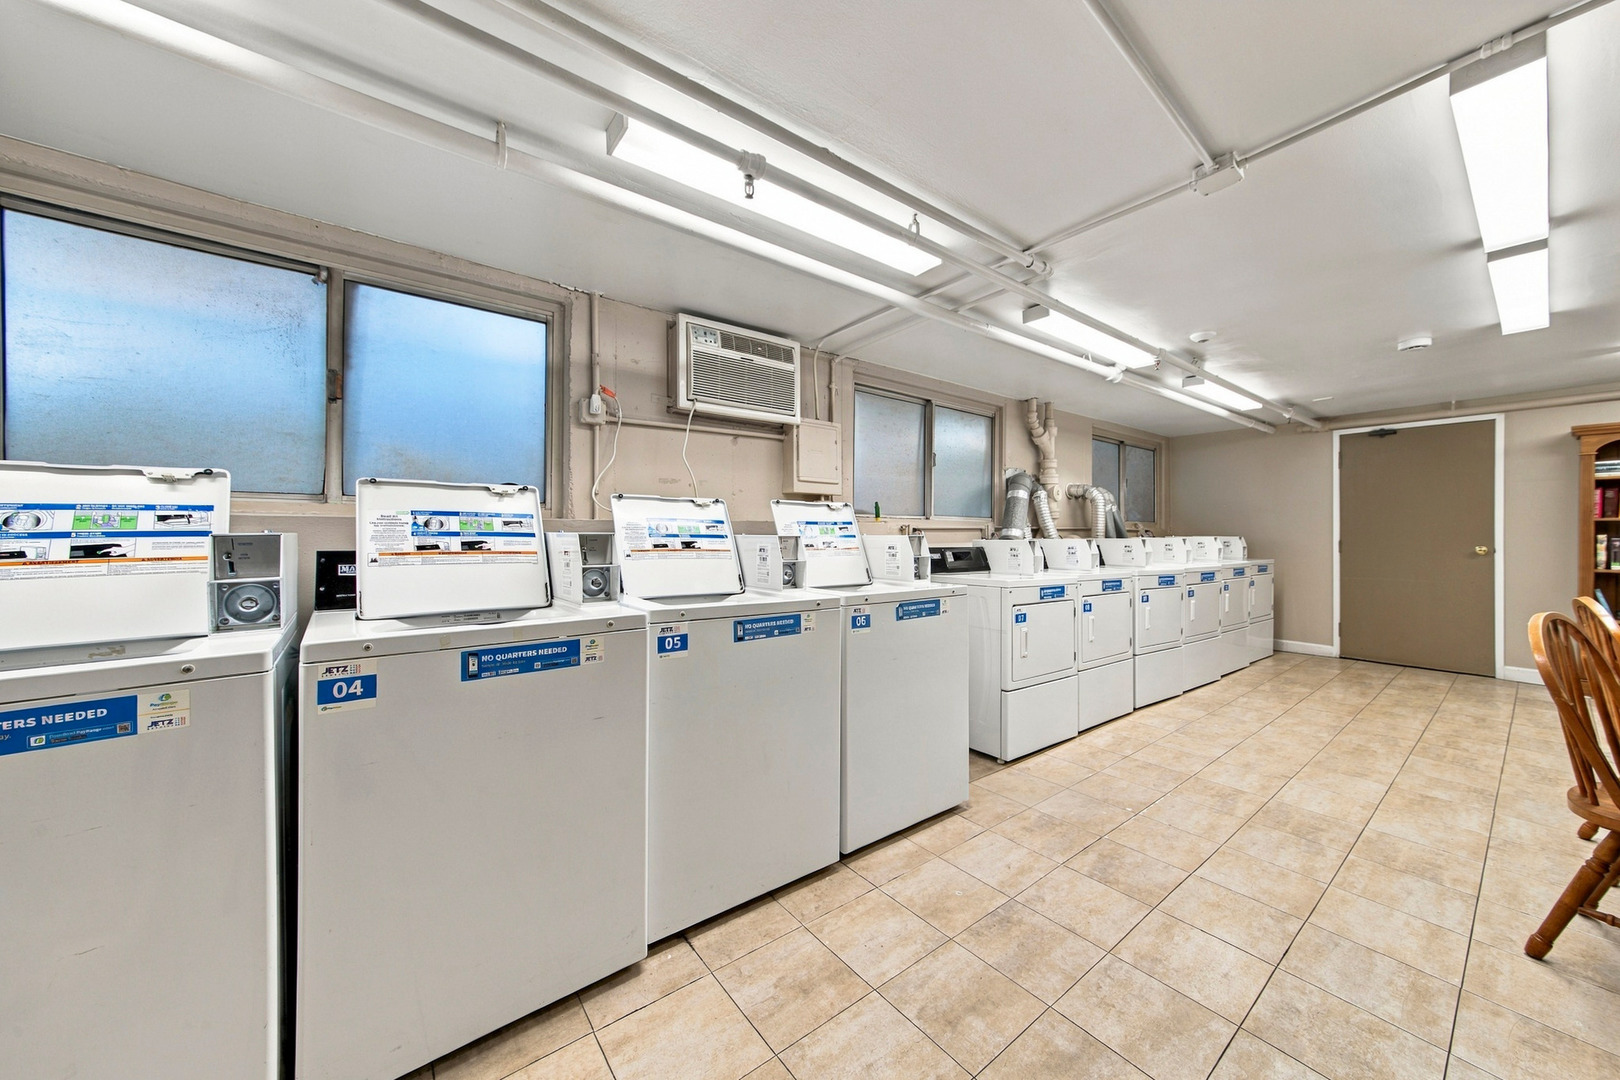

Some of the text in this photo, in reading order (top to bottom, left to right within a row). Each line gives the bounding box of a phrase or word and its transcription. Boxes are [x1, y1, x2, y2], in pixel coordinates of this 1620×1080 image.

[777, 618, 794, 626] NEEDED
[856, 616, 866, 627] 06
[665, 636, 681, 650] 05
[481, 654, 494, 662] NO
[495, 650, 537, 661] QUARTERS
[538, 646, 568, 656] NEEDED
[321, 664, 349, 675] JETZ
[332, 679, 364, 699] 04
[41, 708, 108, 725] NEEDED
[147, 718, 174, 728] JETZ
